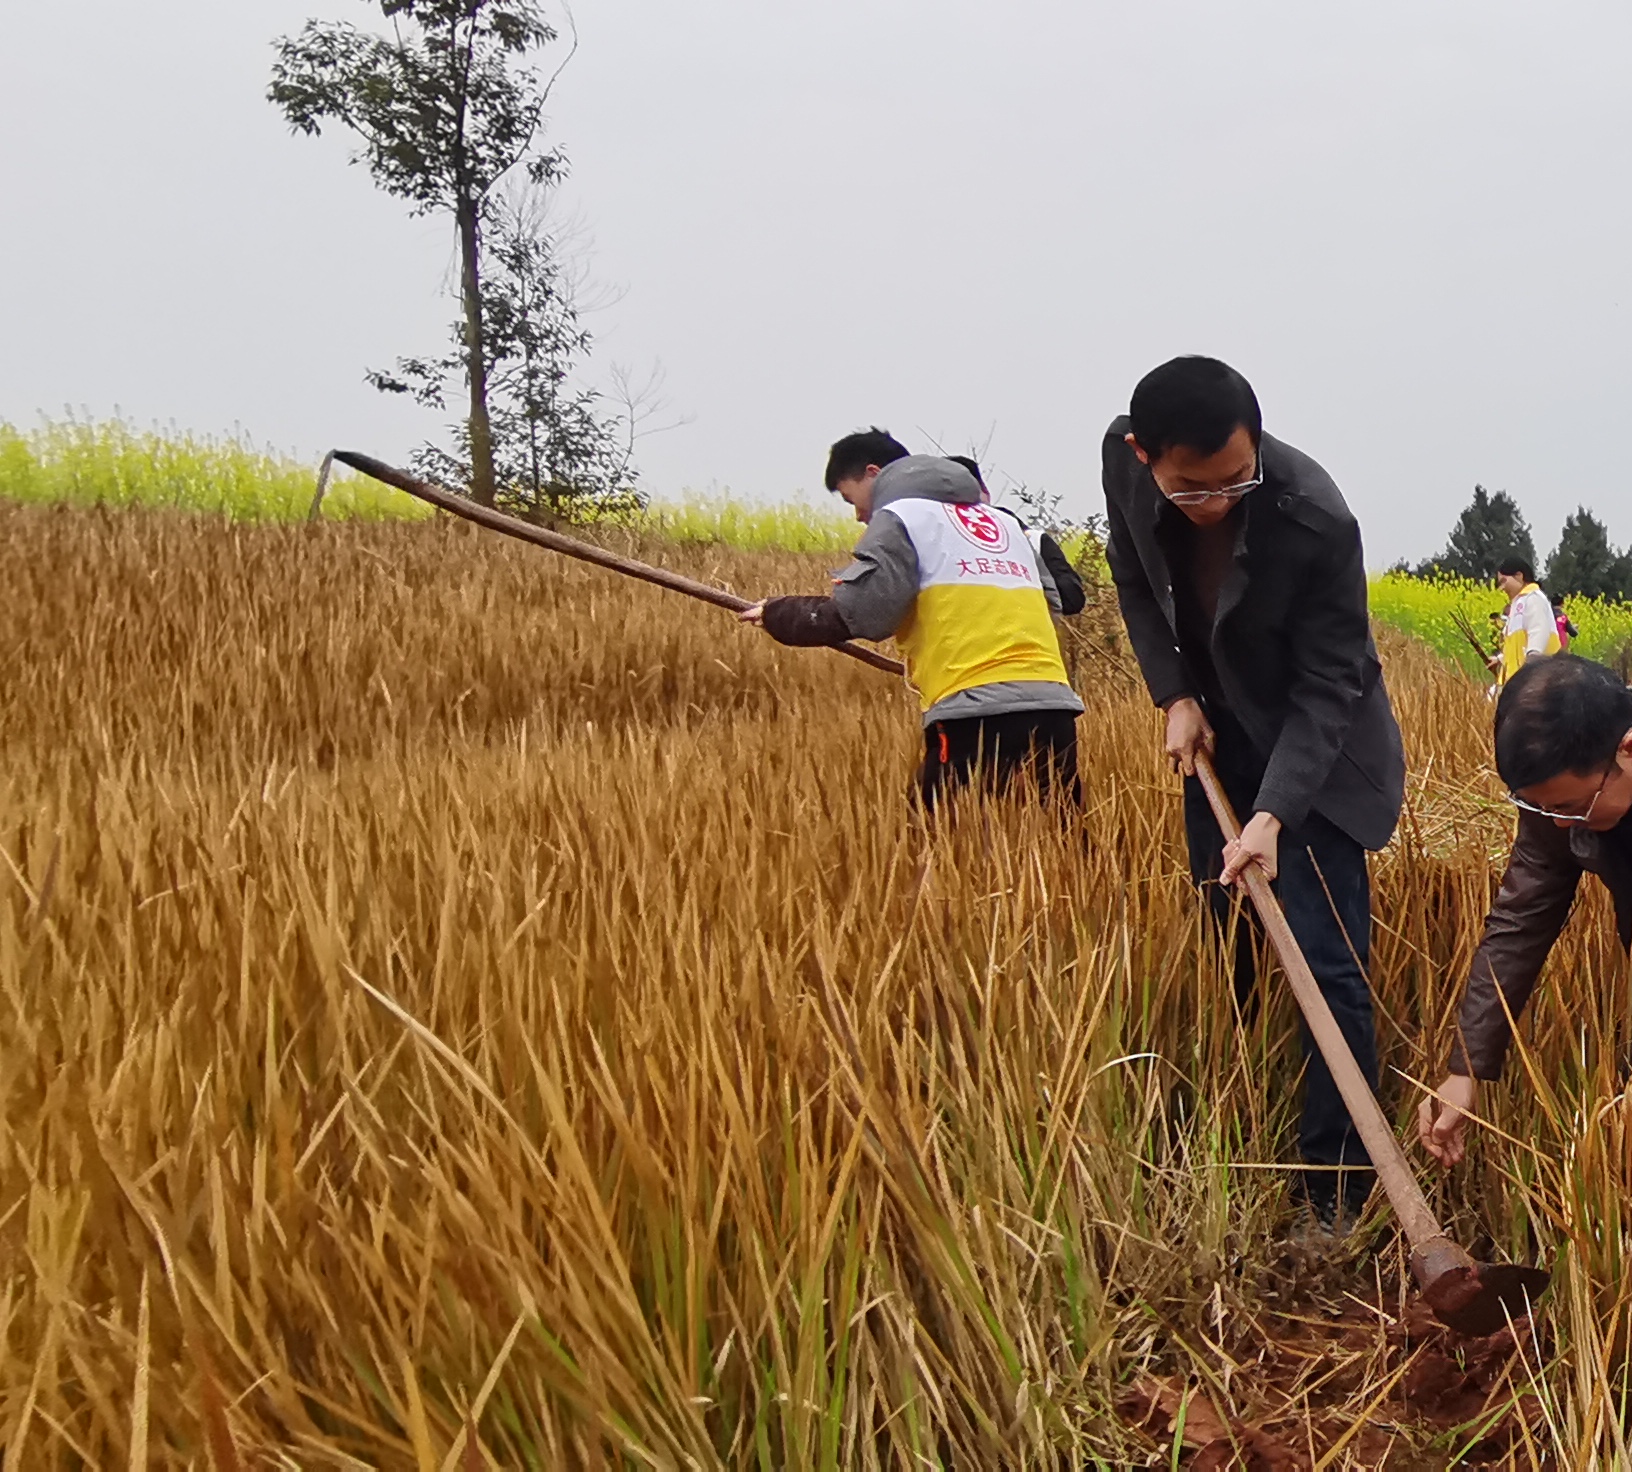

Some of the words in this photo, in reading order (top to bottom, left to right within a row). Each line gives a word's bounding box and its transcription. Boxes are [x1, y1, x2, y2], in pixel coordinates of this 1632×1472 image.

[955, 557, 1032, 582] 大足志愿者
